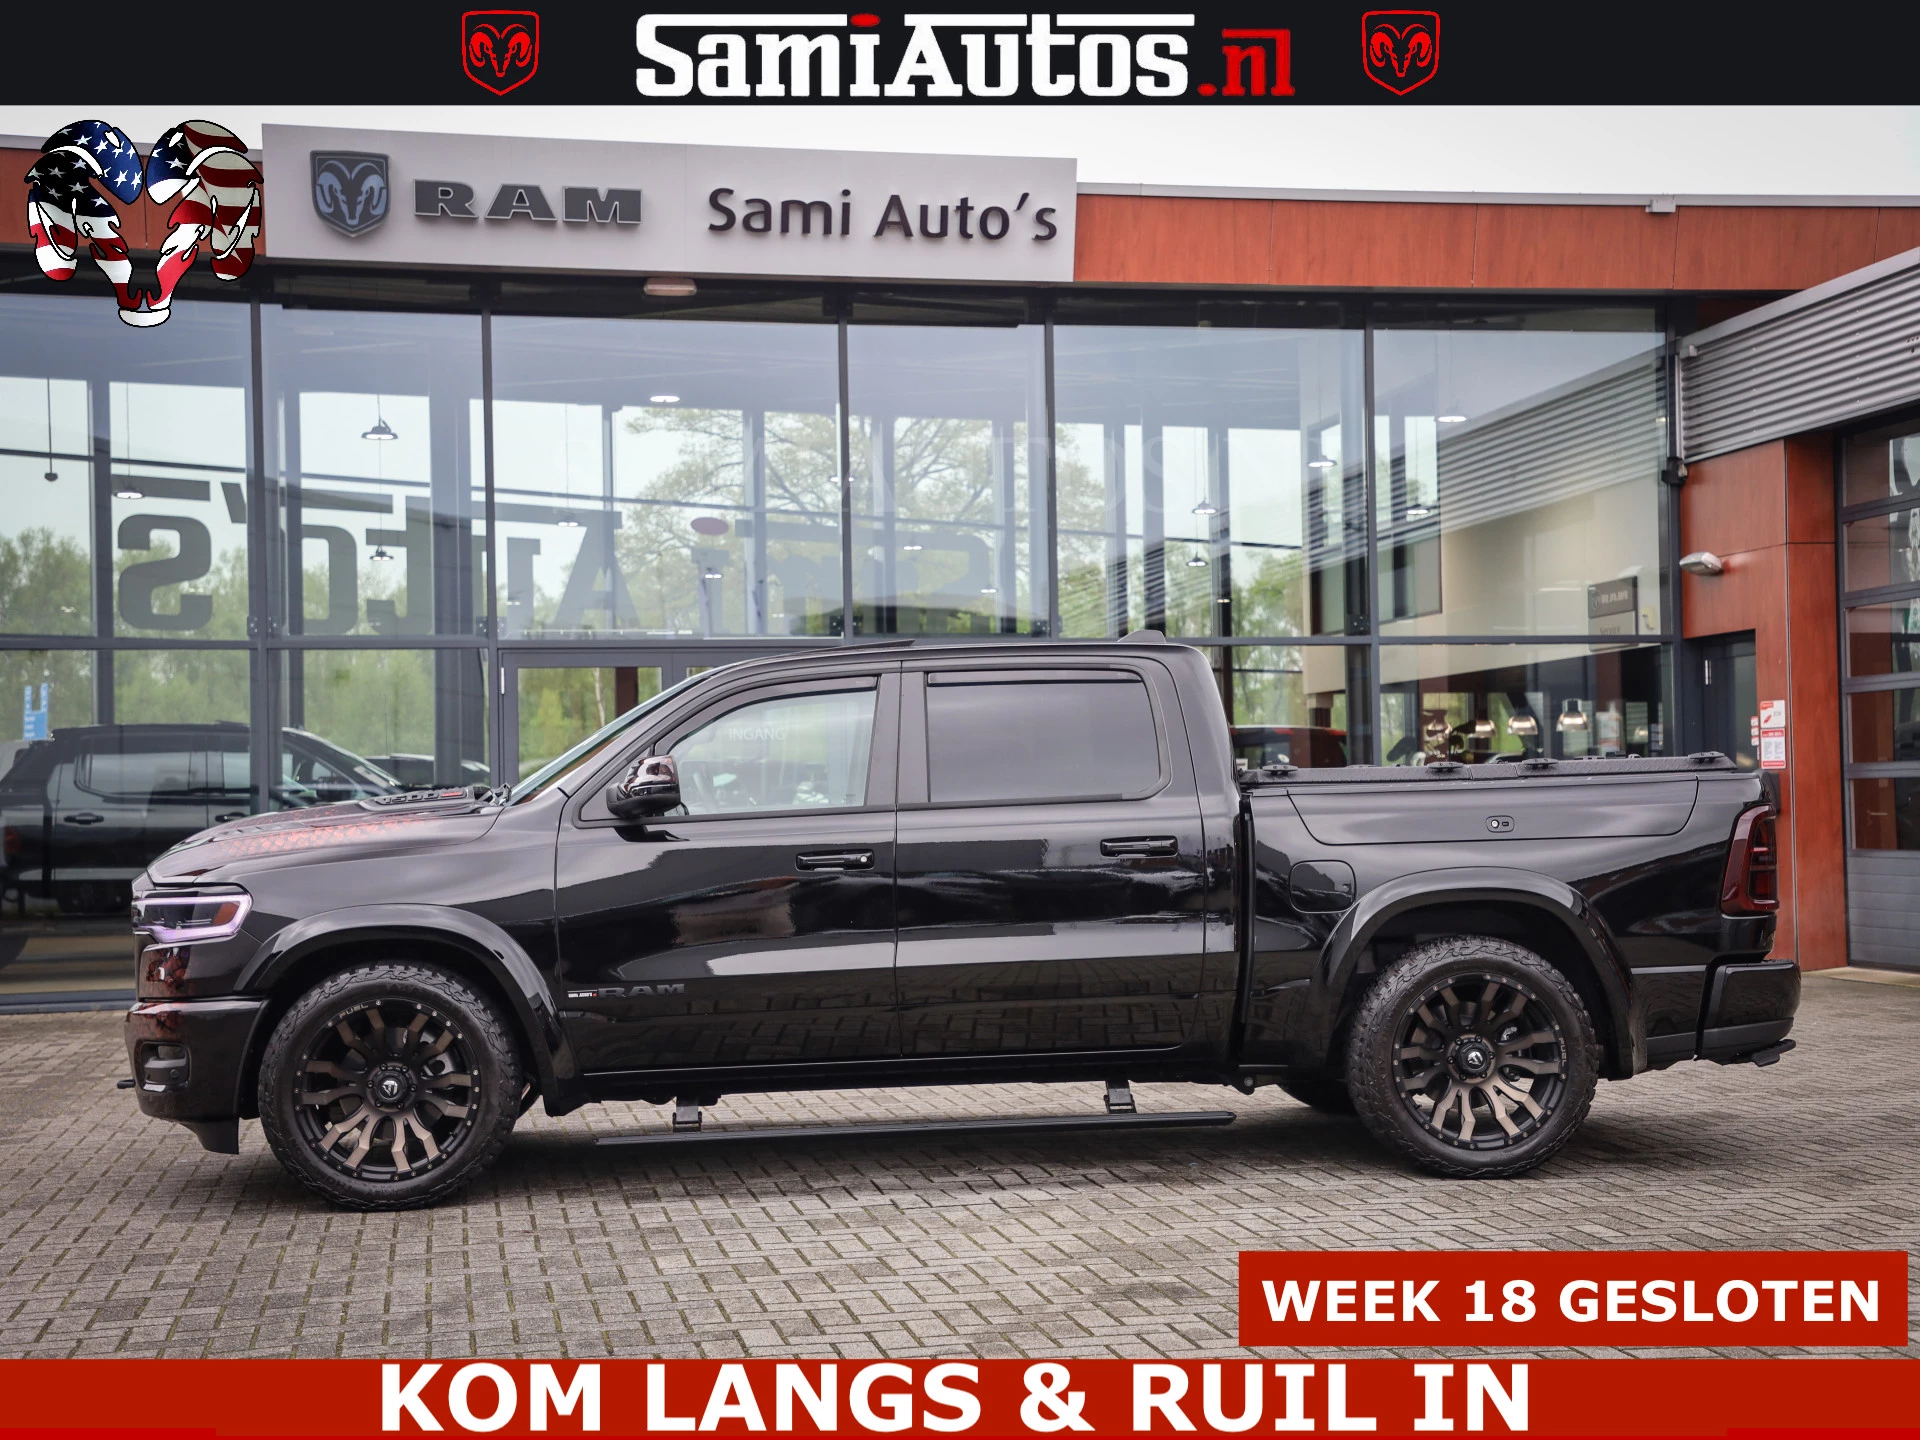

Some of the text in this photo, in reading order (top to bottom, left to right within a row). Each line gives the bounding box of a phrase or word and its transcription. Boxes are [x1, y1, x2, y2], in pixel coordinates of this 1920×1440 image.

[414, 179, 642, 226] RAM
[708, 188, 1057, 241] Sami Auto's
[1601, 590, 1628, 604] RAM
[729, 727, 786, 741] INGANG
[598, 983, 685, 998] RAM
[339, 1003, 369, 1019] FUEL
